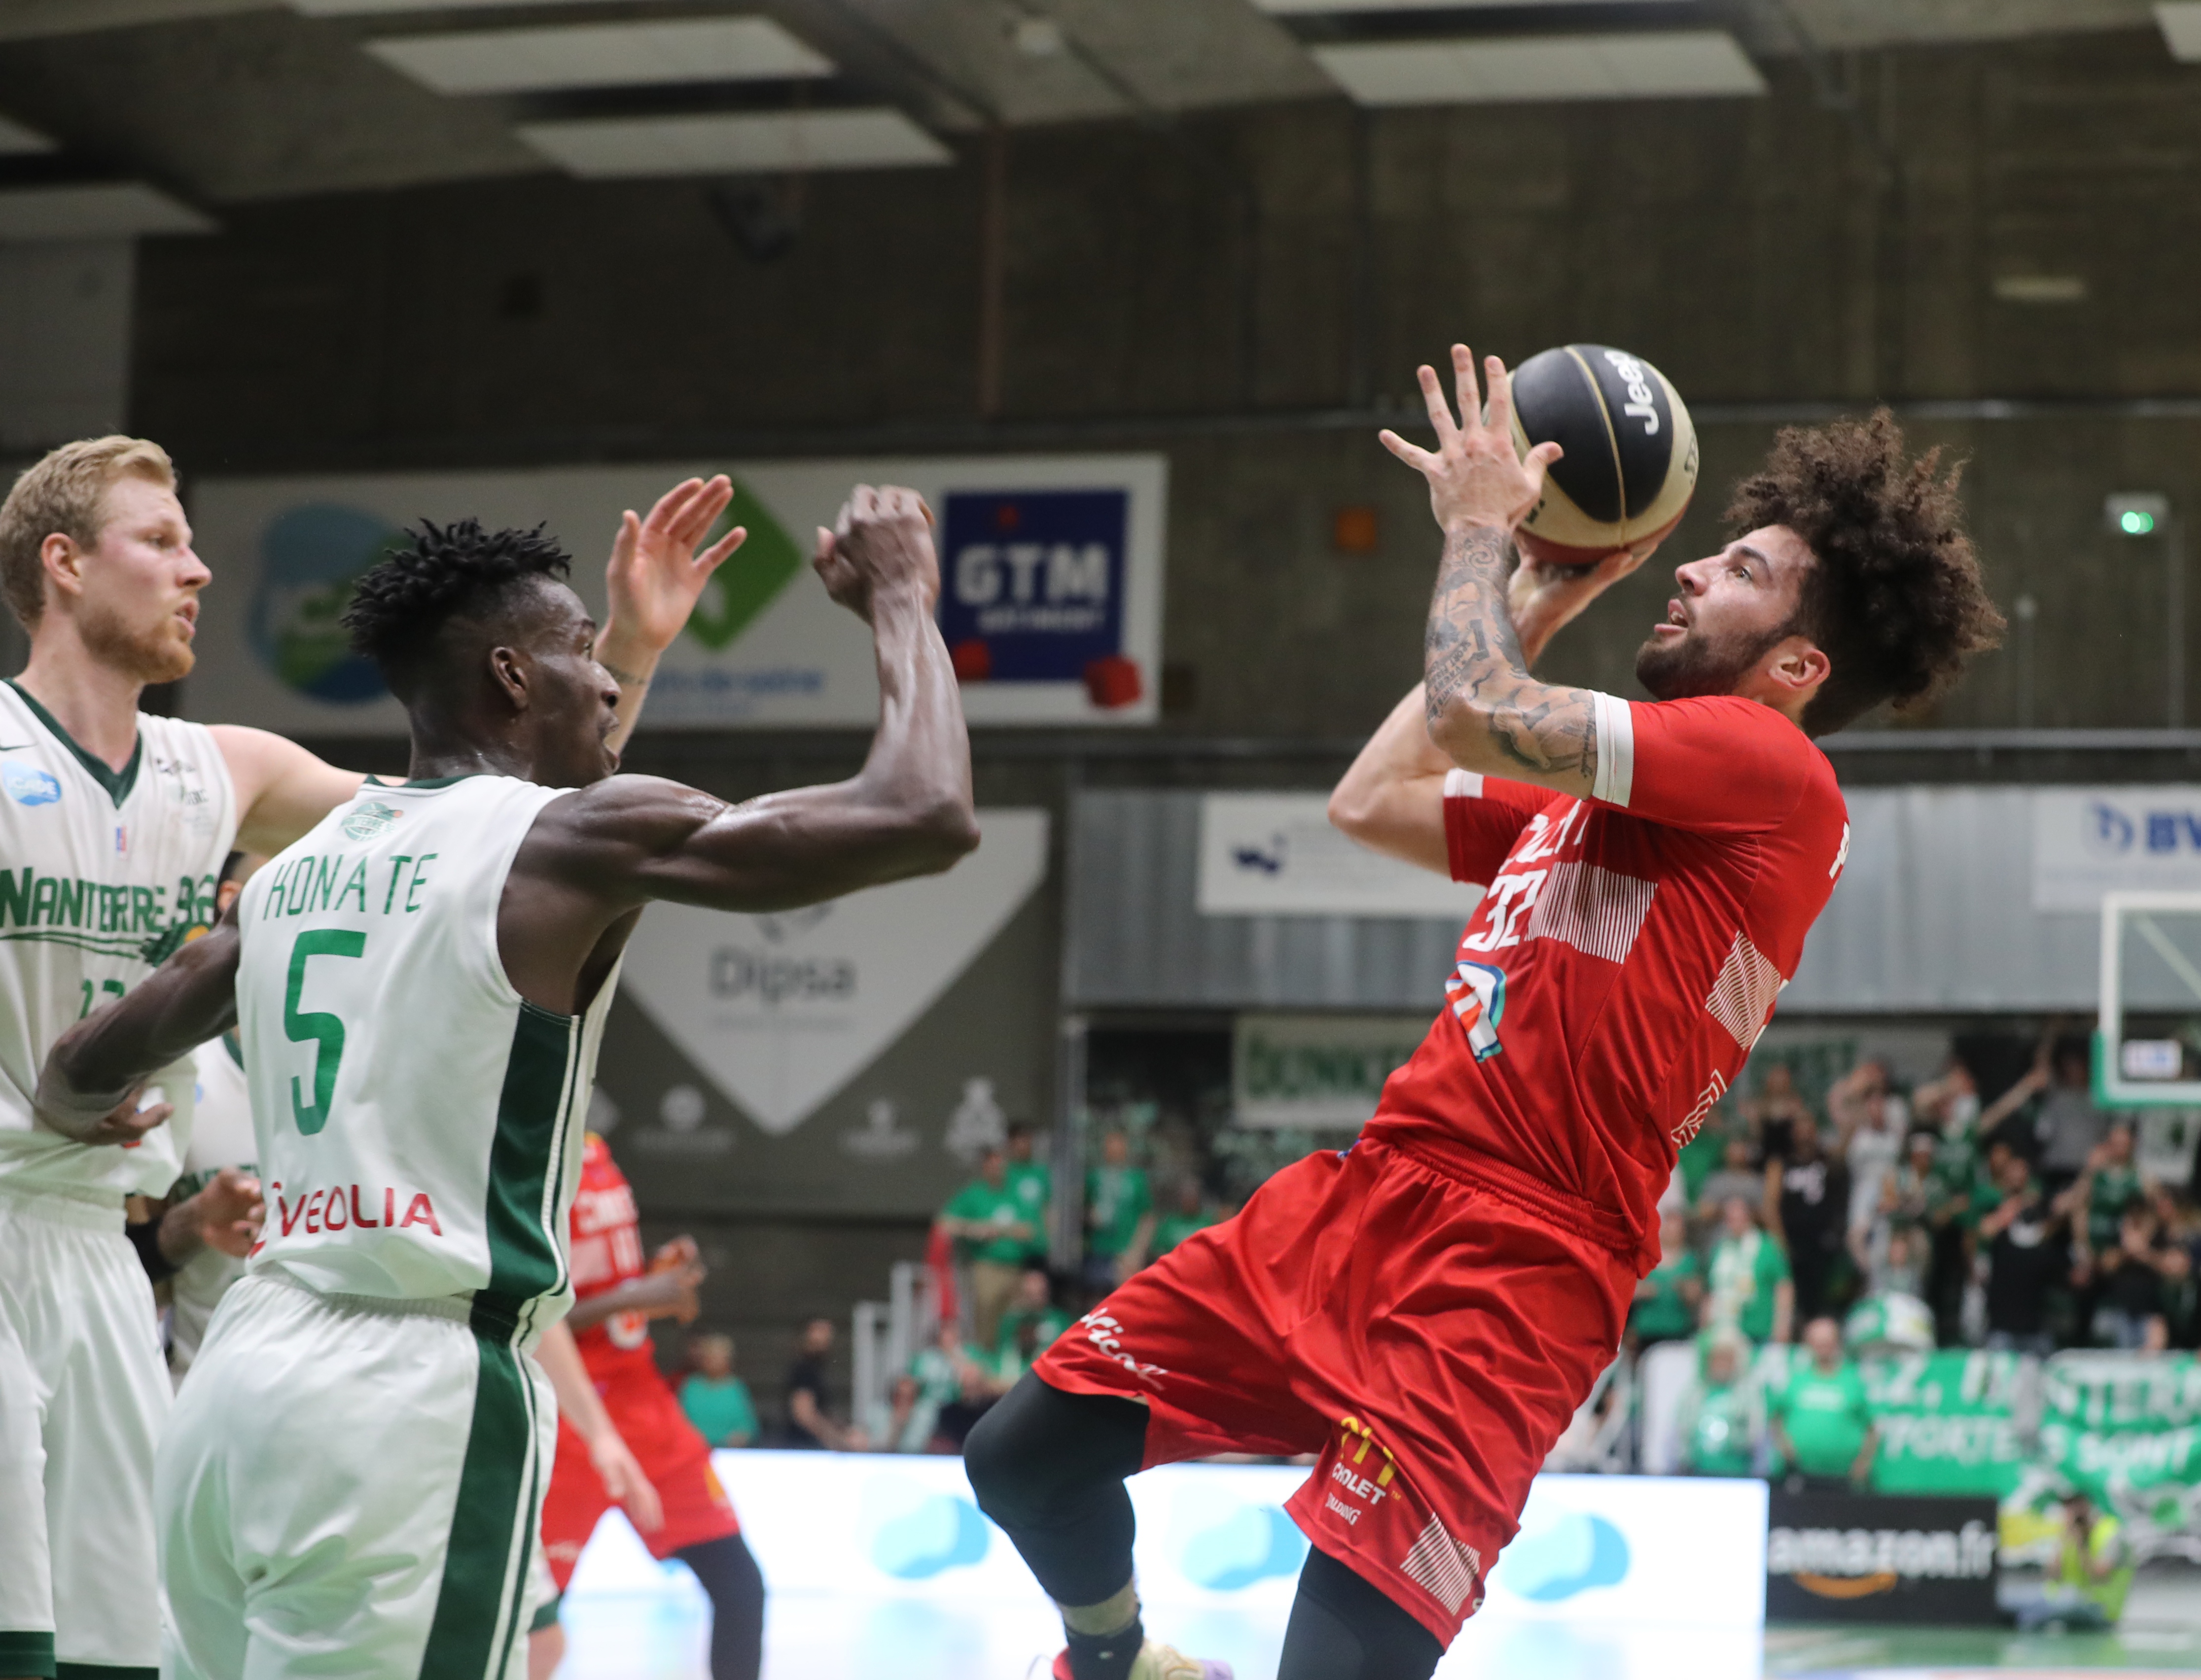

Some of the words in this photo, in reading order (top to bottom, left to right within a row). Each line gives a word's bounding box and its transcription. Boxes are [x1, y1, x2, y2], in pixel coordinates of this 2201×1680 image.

[956, 545, 1108, 604] GTM
[263, 853, 438, 920] KONATE
[710, 946, 857, 1009] Dipsa
[284, 929, 367, 1136] 5
[279, 1185, 442, 1236] VEOLIA
[1332, 1462, 1386, 1505] CHOLET
[1769, 1520, 1998, 1578] amazon.fr
